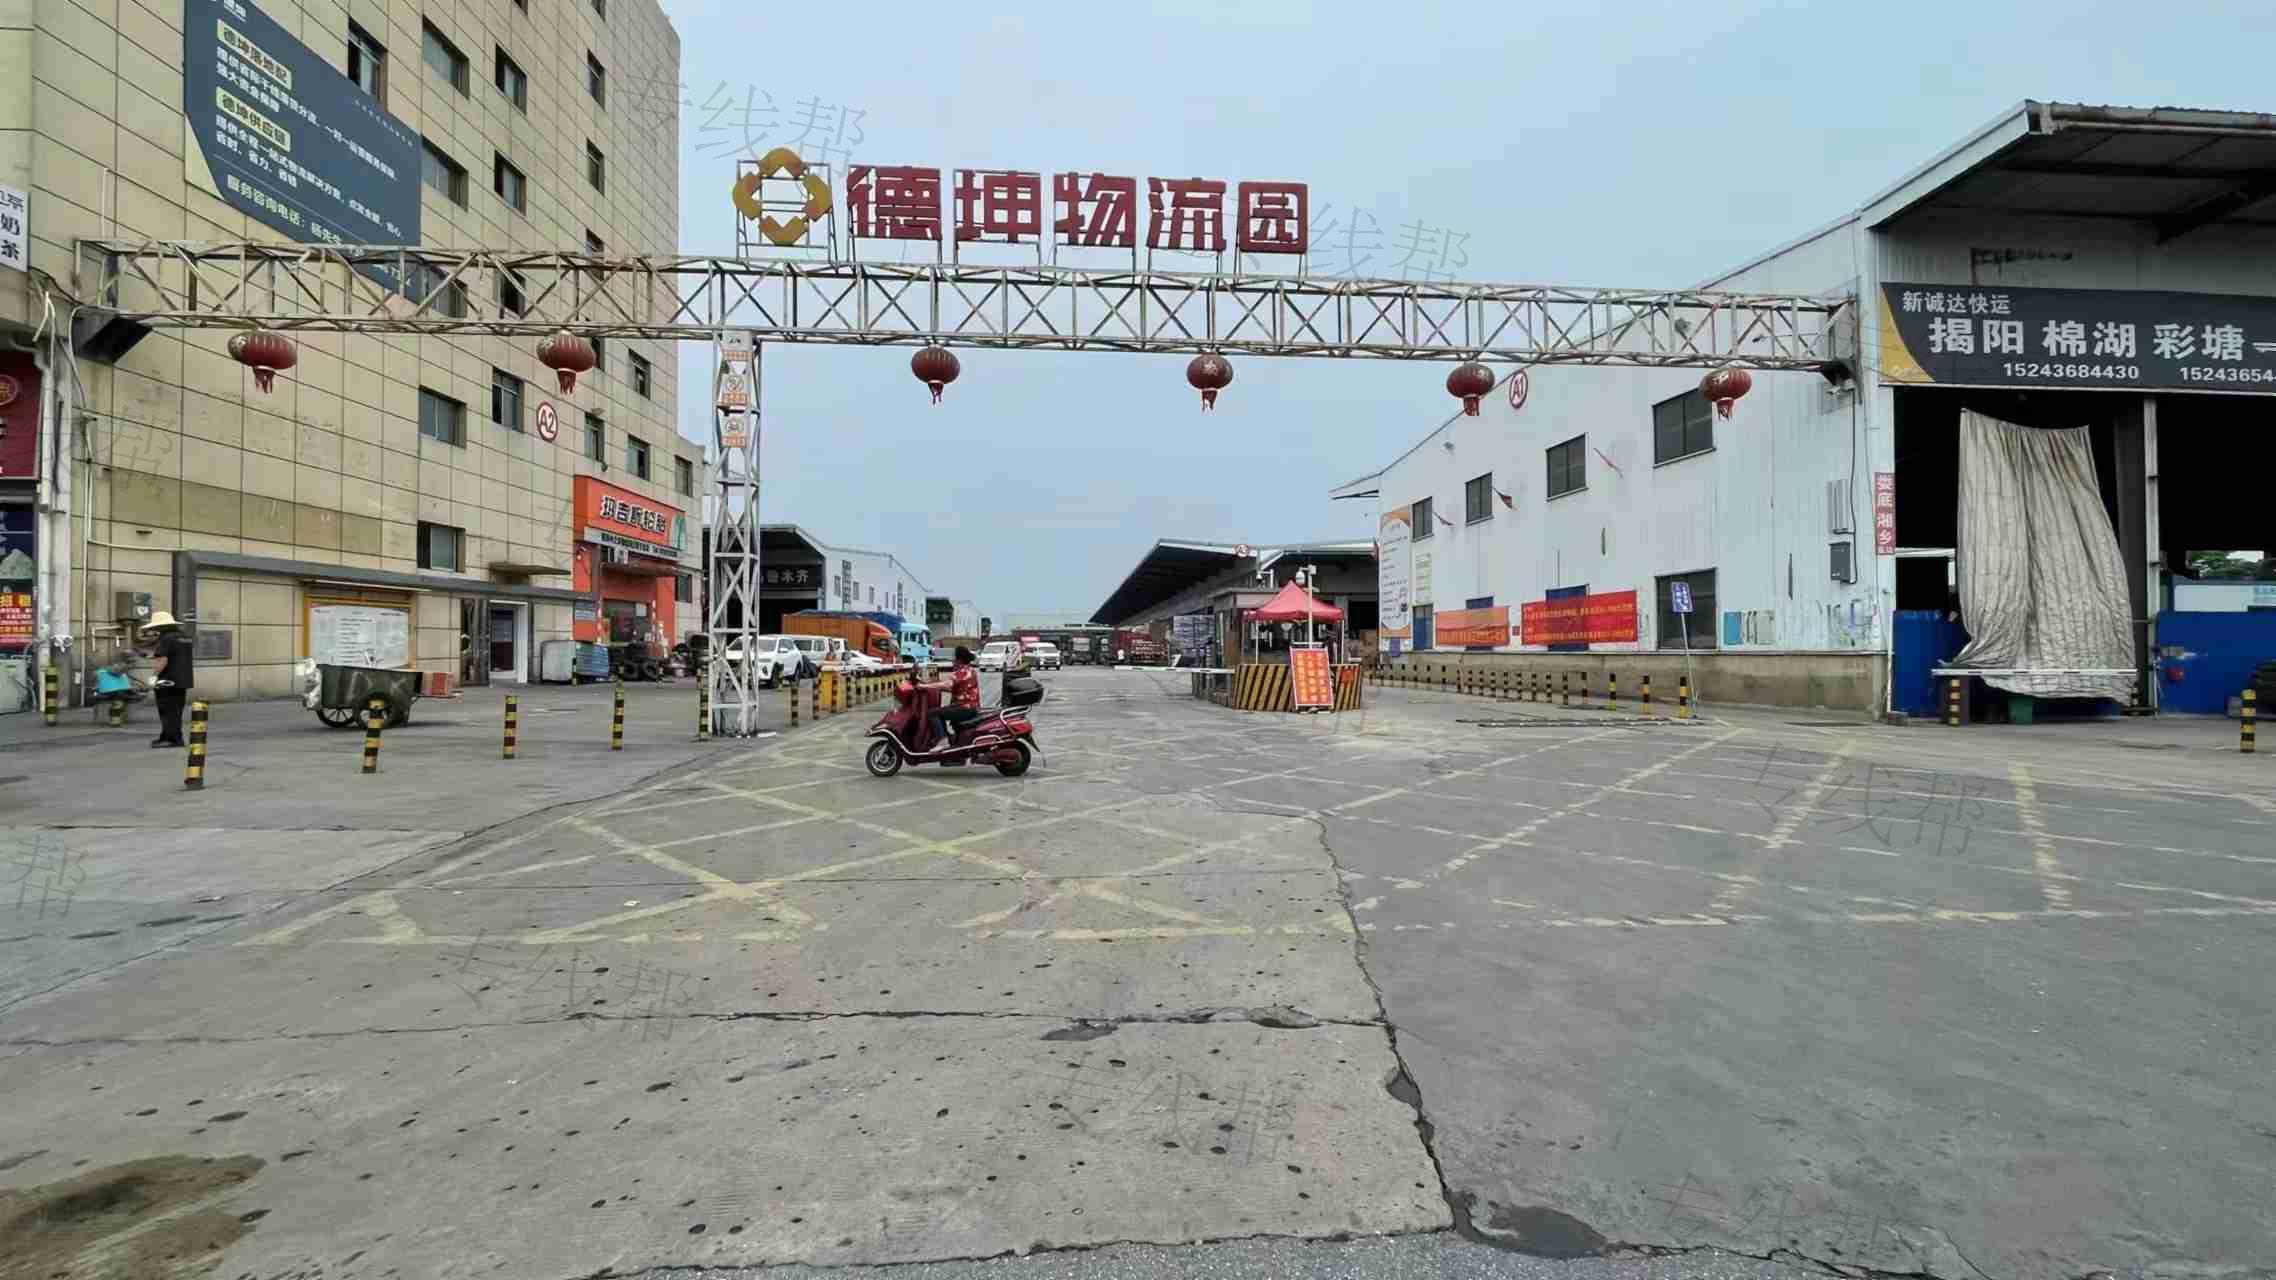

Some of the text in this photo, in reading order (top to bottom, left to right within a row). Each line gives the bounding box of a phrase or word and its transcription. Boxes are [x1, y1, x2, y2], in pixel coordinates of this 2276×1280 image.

[847, 165, 1308, 254] 德坤物流园
[1902, 290, 2013, 315] 新诚达快运
[1928, 317, 2025, 356] 揭阳
[2042, 320, 2138, 359] 棉湖
[2152, 323, 2246, 362] 彩塘
[2003, 362, 2140, 381] 15243684430
[2179, 366, 2276, 383] 15243654
[760, 569, 809, 585] 鲁木齐
